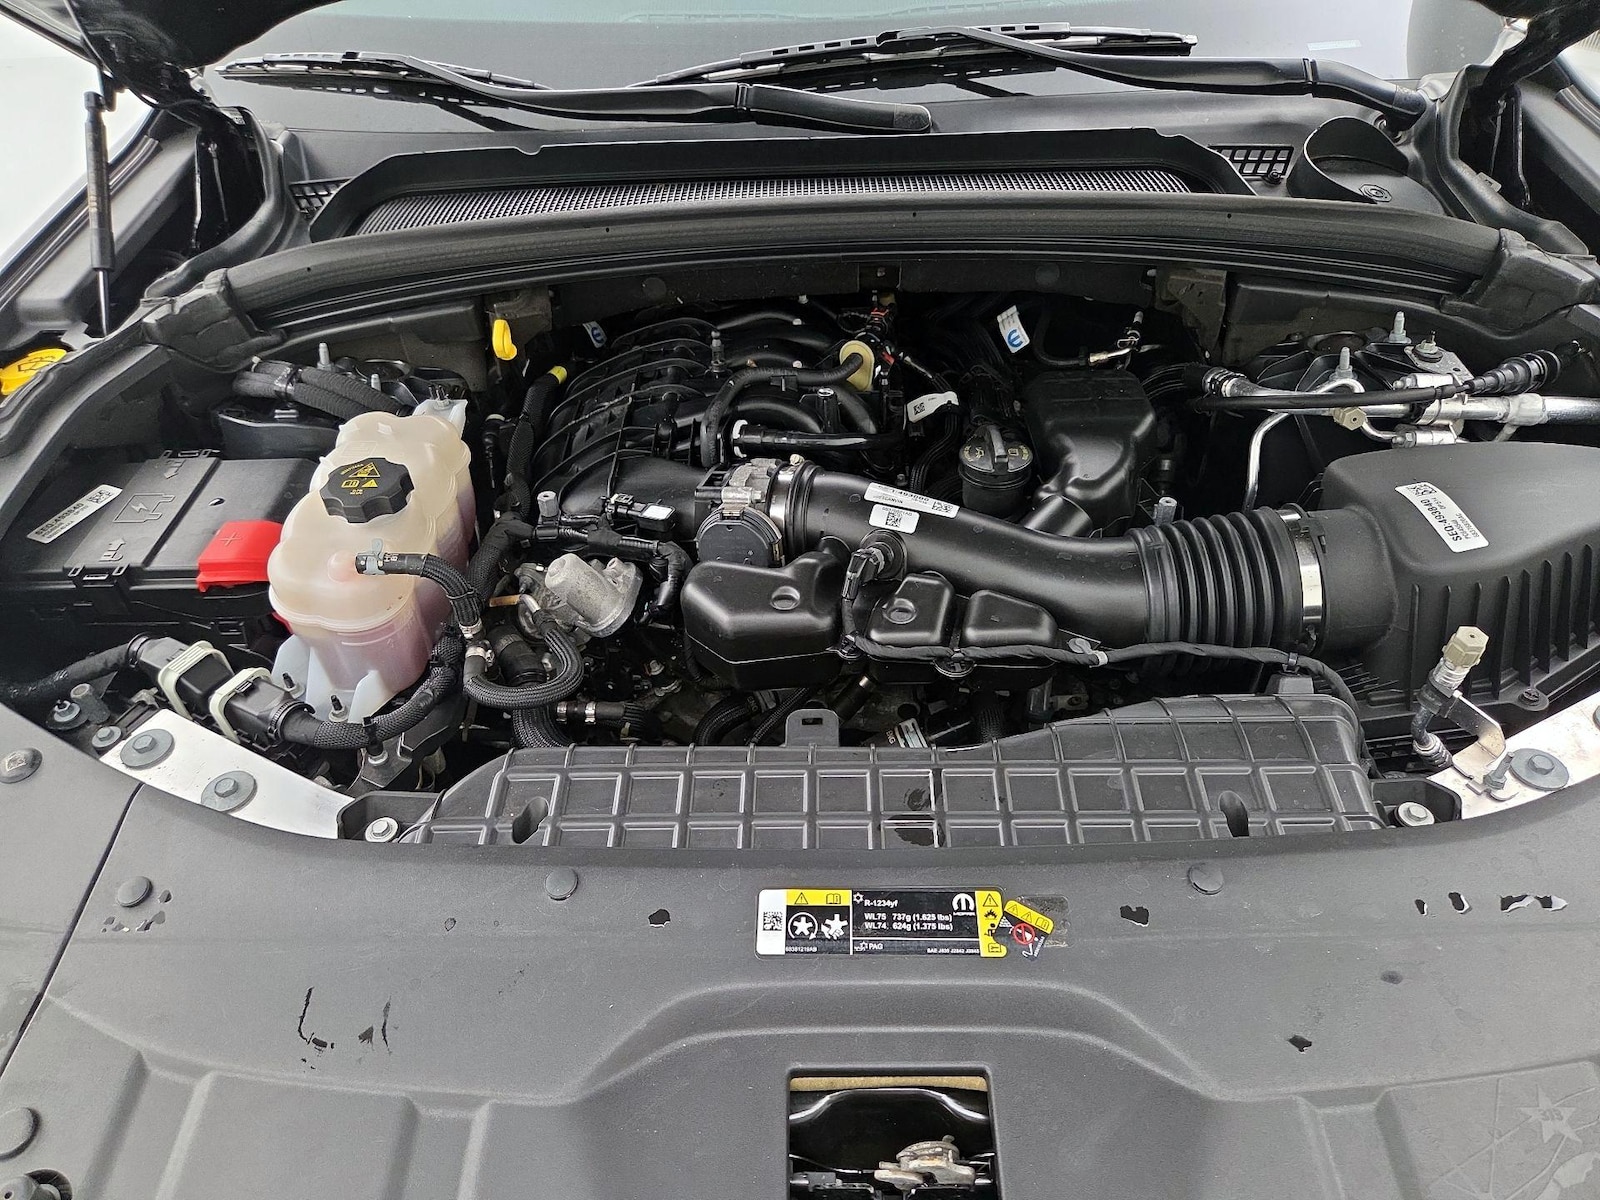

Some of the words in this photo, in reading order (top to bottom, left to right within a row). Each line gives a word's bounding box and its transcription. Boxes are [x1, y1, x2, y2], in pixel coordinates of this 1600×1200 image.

[1420, 498, 1463, 542] SEQ:493840
[864, 899, 899, 908] R-1234yf
[864, 913, 887, 921] WL75
[892, 913, 911, 922] 737g
[912, 913, 936, 923] (1.625
[937, 913, 953, 923] lbs)
[892, 922, 911, 931] 624g
[912, 922, 937, 931] (1.375
[938, 922, 953, 931] lbs)
[868, 942, 884, 950] PAG
